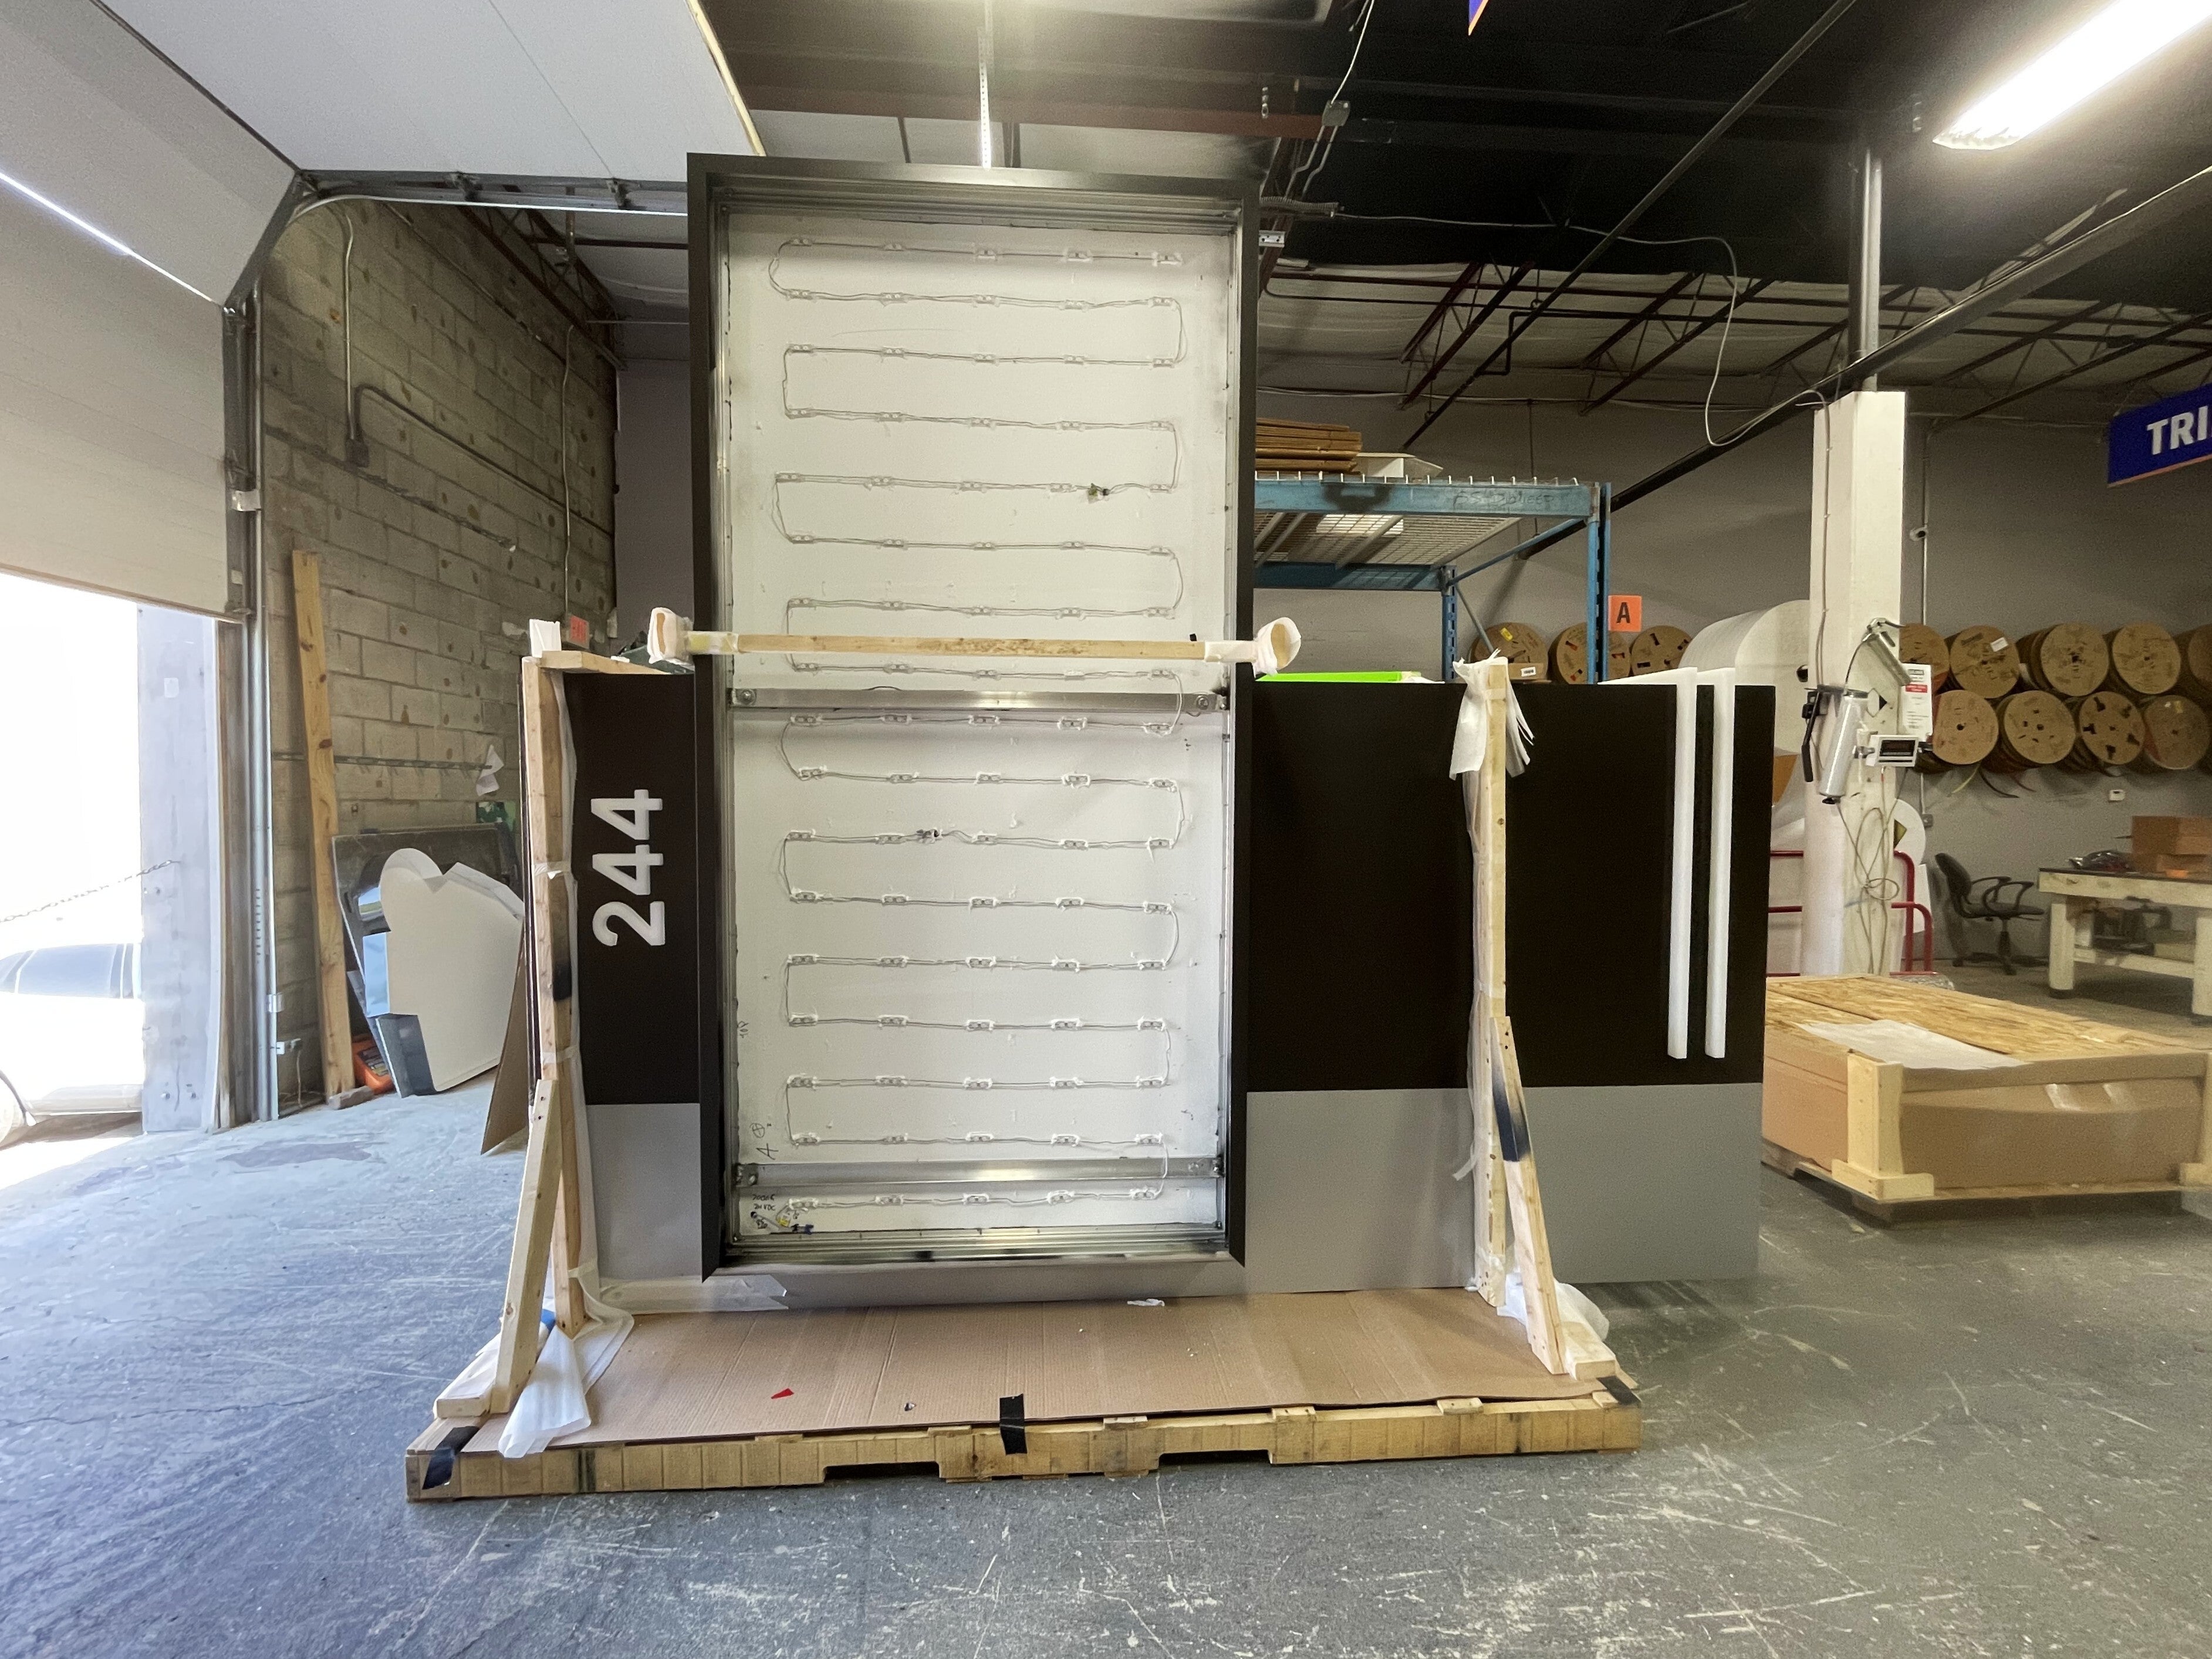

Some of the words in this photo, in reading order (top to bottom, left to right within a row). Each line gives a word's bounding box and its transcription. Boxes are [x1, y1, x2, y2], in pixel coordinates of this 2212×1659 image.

[2146, 406, 2212, 455] TRI
[1616, 602, 1630, 623] A
[590, 789, 665, 946] 244
